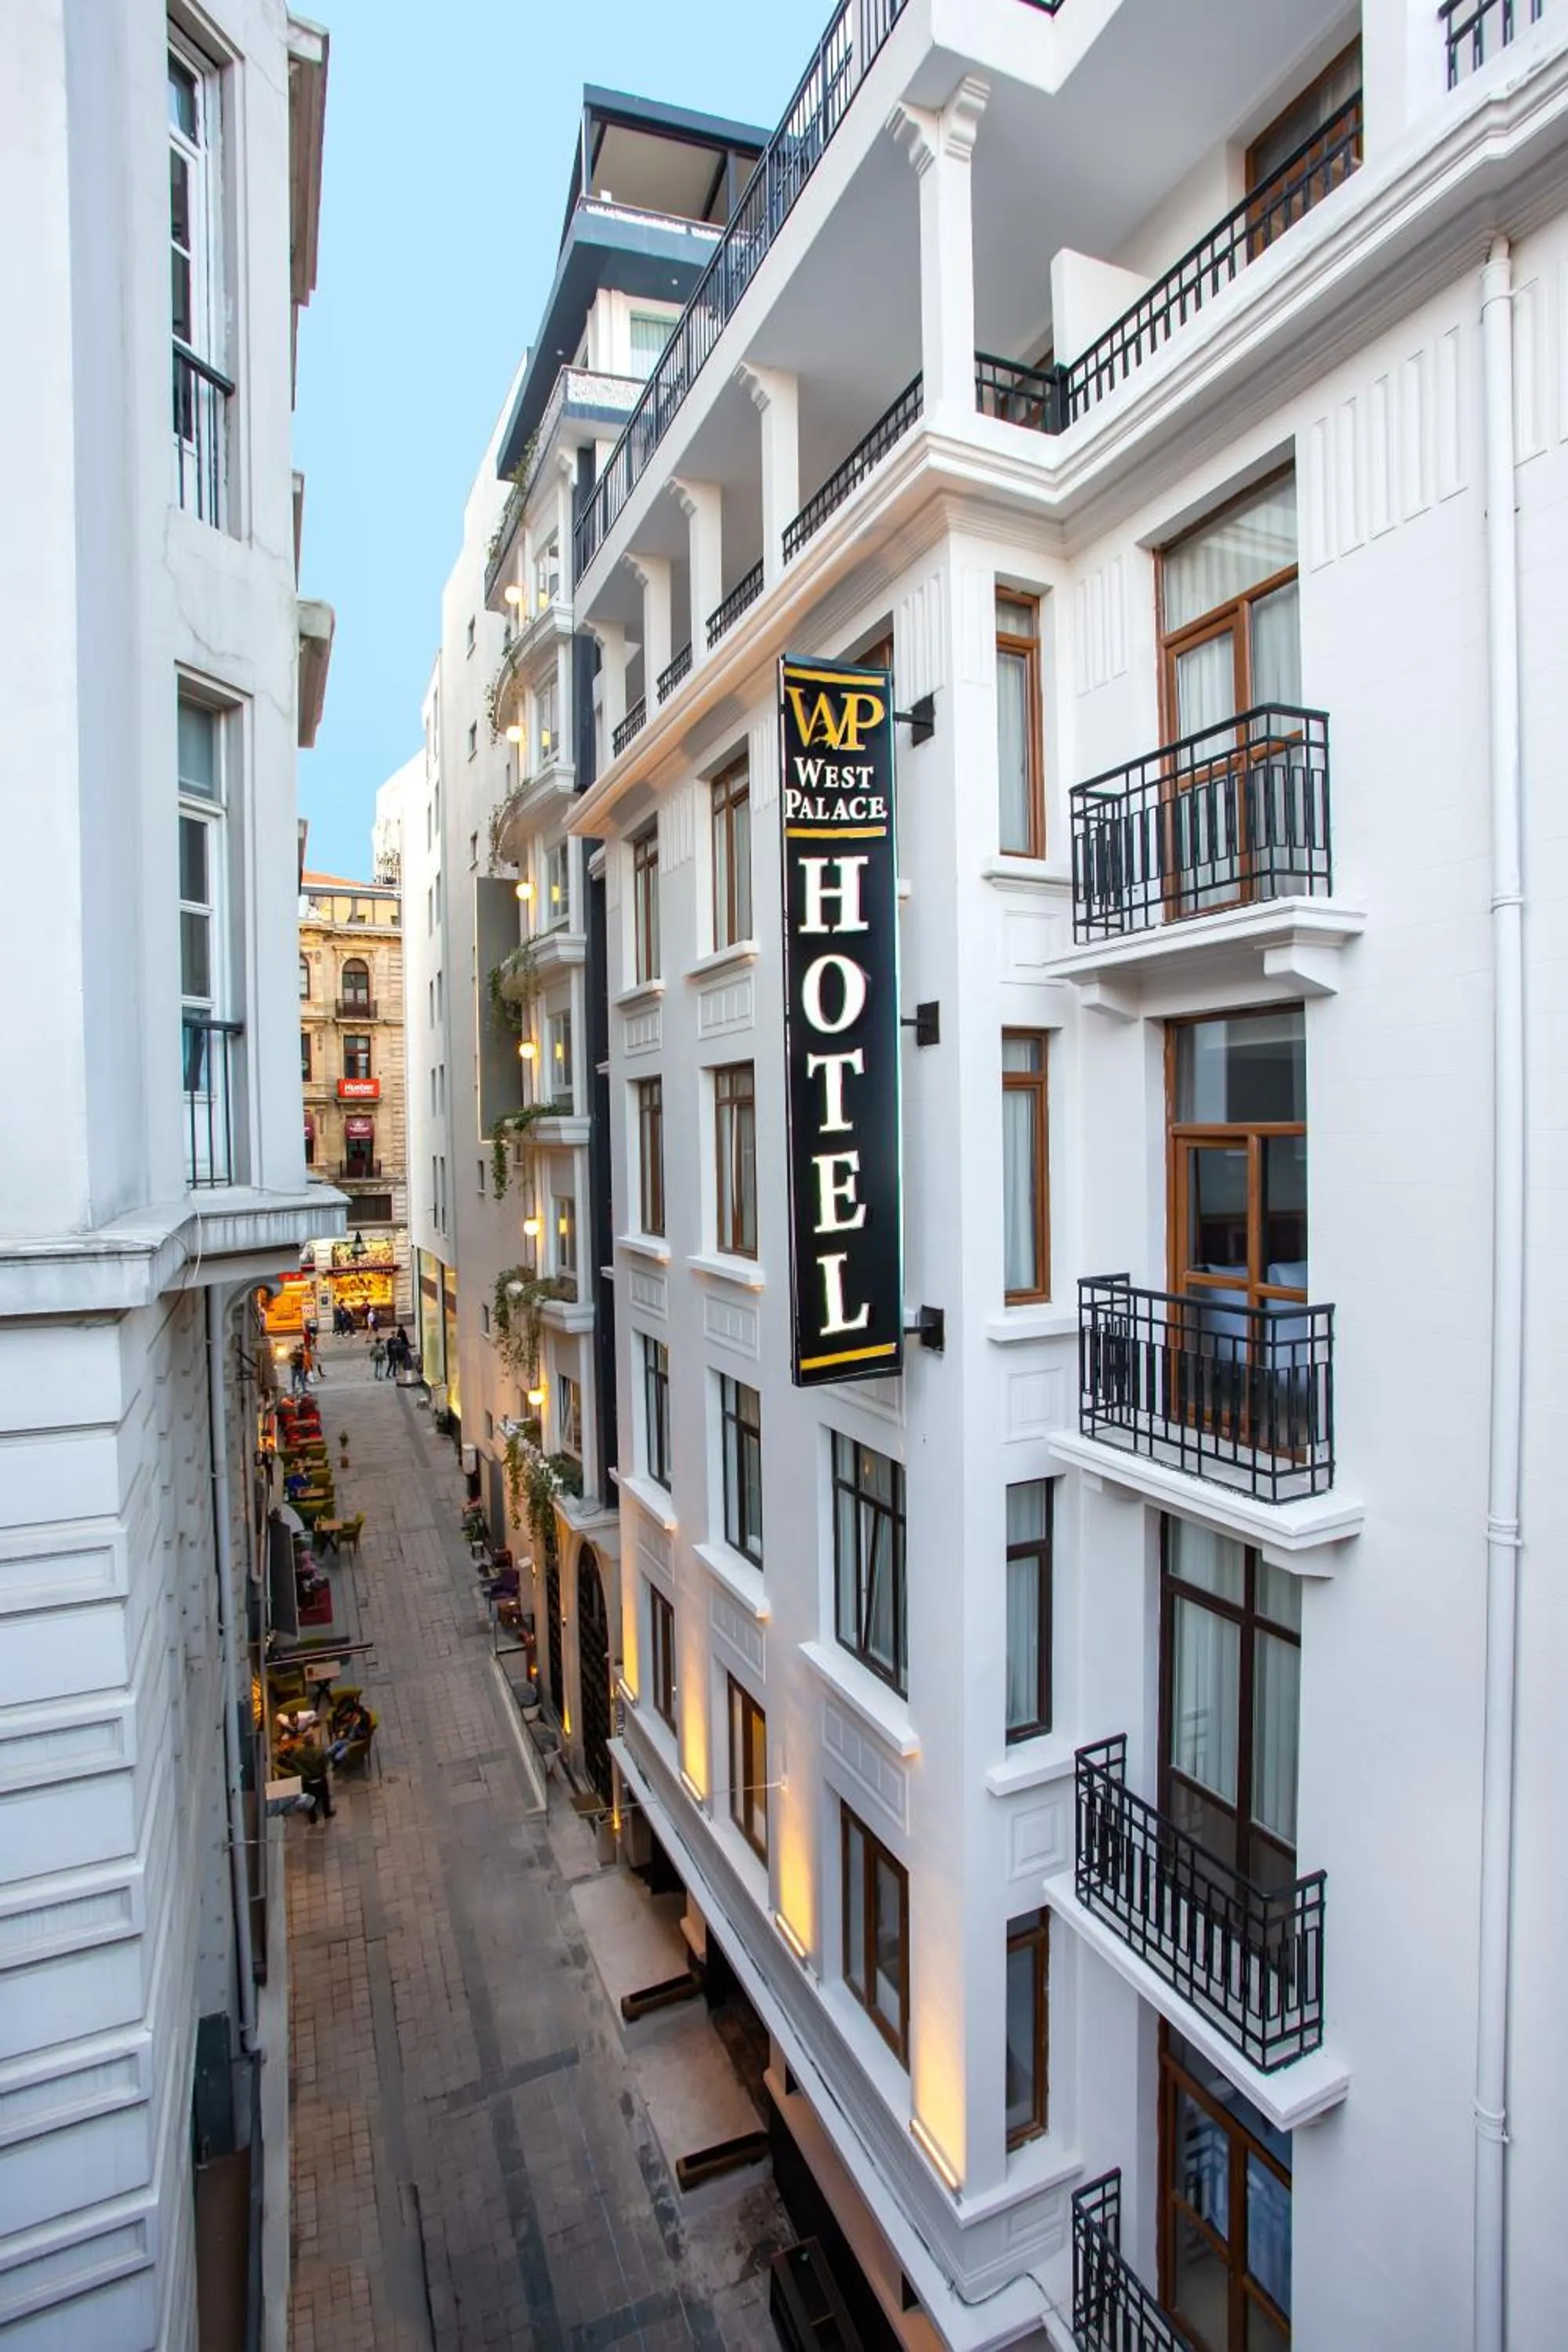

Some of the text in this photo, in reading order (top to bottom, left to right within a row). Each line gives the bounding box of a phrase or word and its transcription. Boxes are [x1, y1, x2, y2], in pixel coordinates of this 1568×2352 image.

[793, 757, 874, 789] WEST
[785, 789, 887, 821] PALACE
[797, 855, 871, 1338] HOTEL
